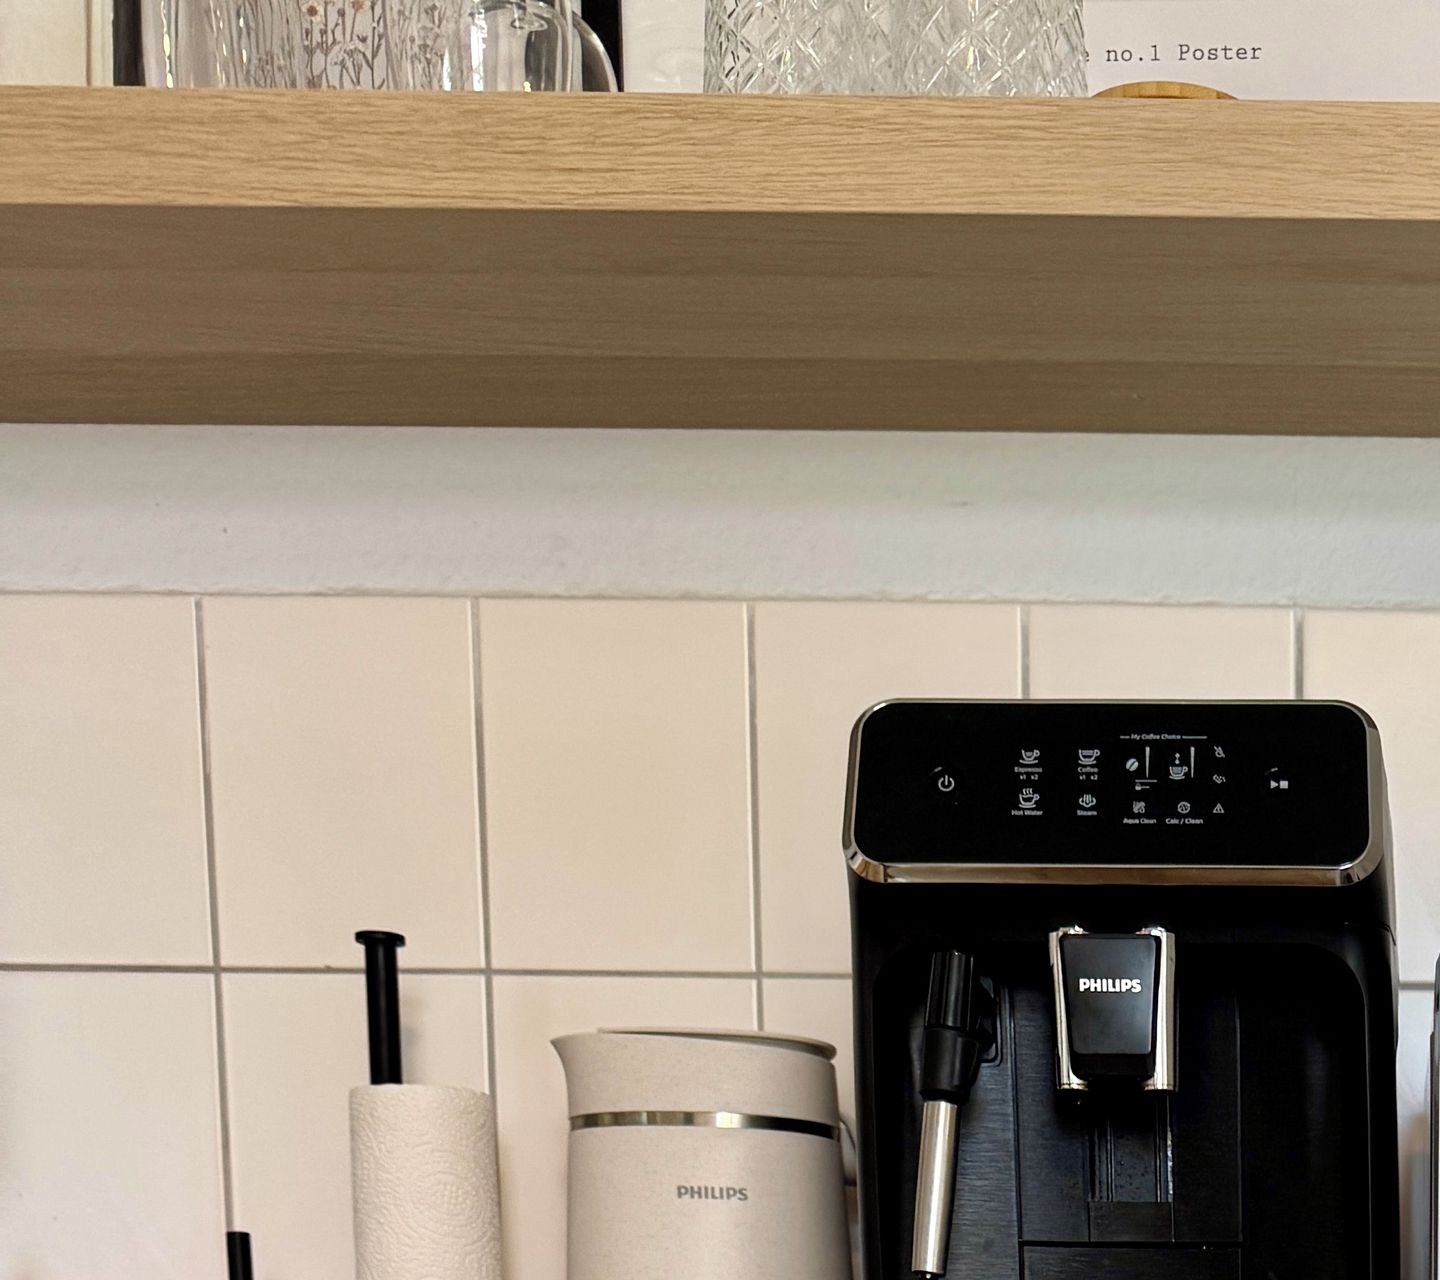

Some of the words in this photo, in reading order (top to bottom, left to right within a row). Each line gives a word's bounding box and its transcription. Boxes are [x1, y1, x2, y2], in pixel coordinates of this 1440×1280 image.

[1106, 44, 1161, 62] no.1
[1178, 43, 1262, 61] Poster
[1014, 766, 1043, 774] Espresso
[1079, 978, 1142, 993] PHILIPS
[677, 1185, 749, 1201] PHILIPS
